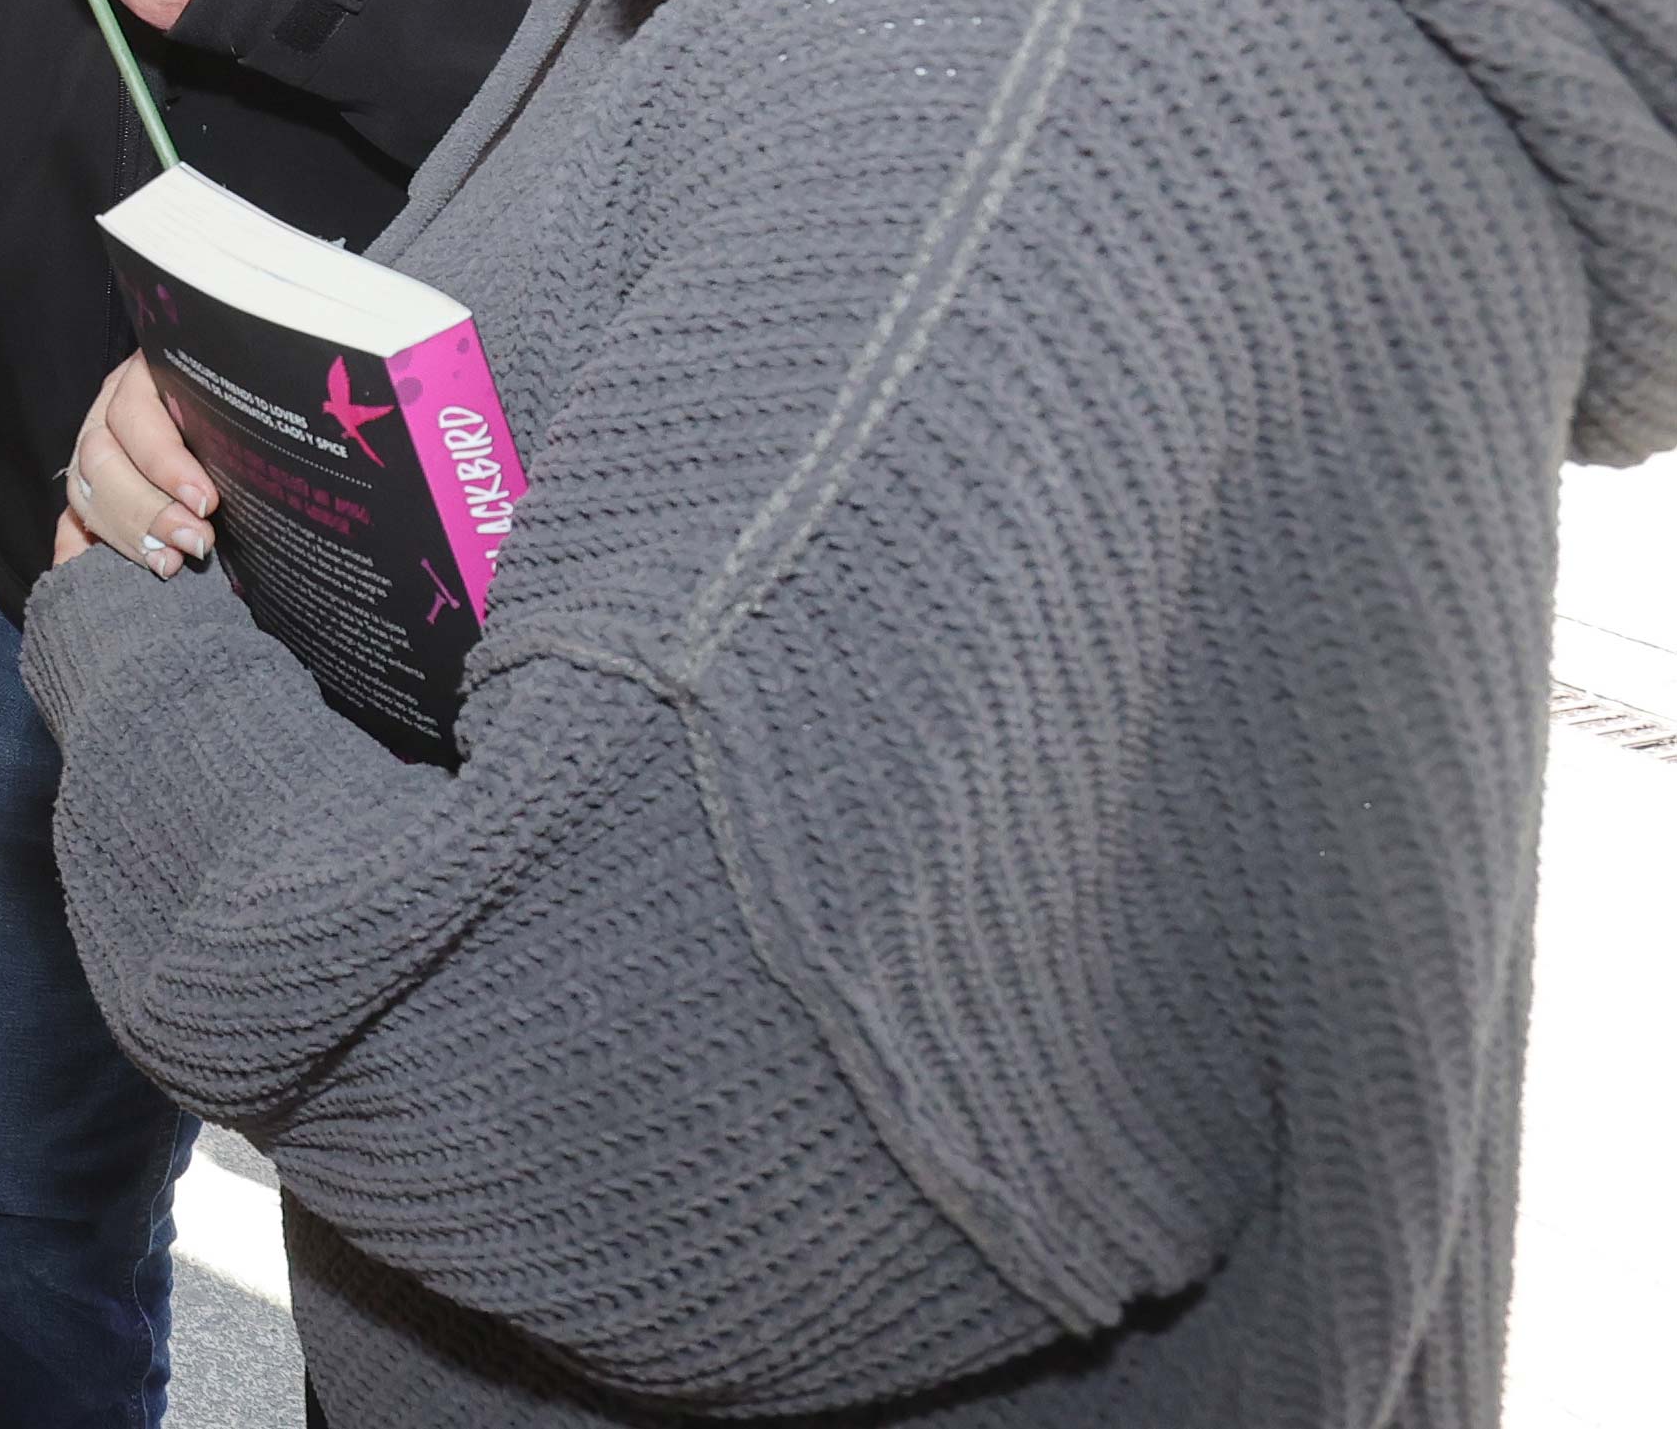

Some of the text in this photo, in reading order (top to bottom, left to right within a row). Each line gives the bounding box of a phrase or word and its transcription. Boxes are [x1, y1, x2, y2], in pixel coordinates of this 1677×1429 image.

[266, 400, 311, 434] LOVERS
[275, 420, 351, 464] CAOS SPICE
[436, 405, 516, 572] ACKBIRD
